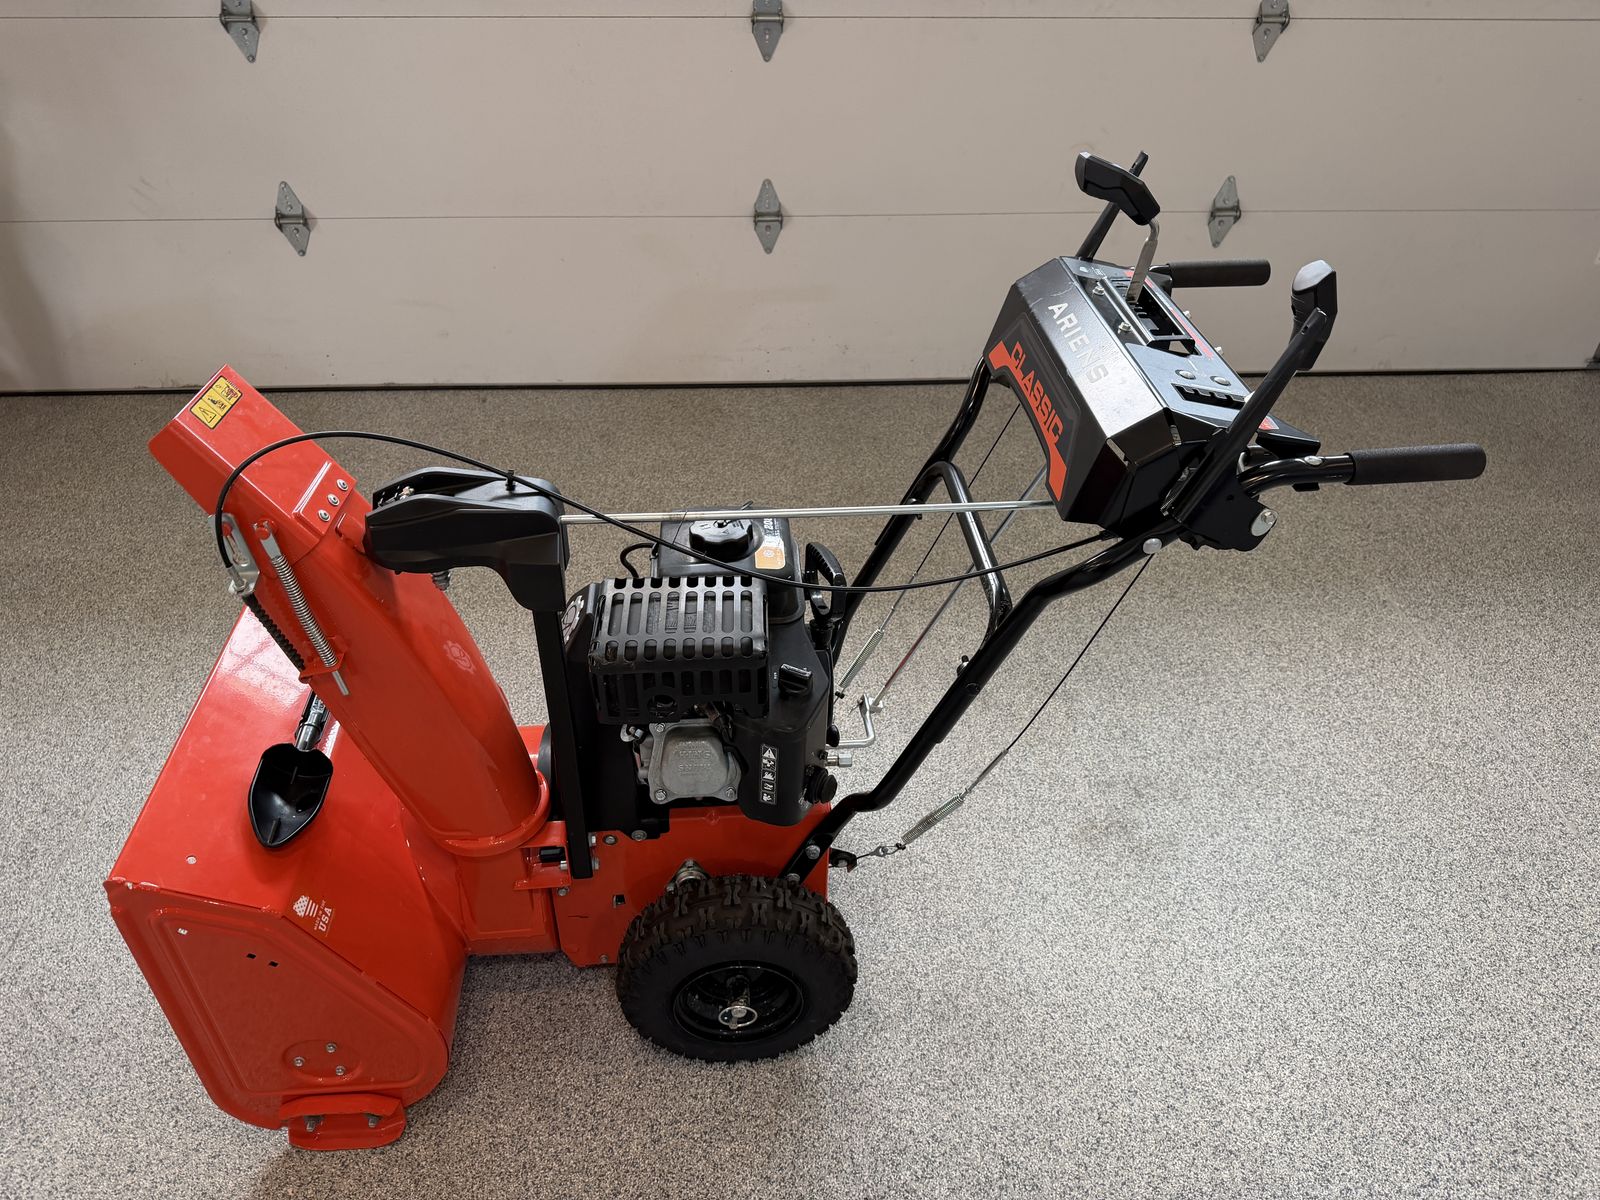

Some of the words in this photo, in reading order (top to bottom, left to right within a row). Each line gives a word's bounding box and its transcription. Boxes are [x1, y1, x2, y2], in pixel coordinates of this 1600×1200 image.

[1047, 302, 1109, 384] ARIENS
[1009, 341, 1065, 445] CLASSIC
[318, 907, 332, 931] USA
